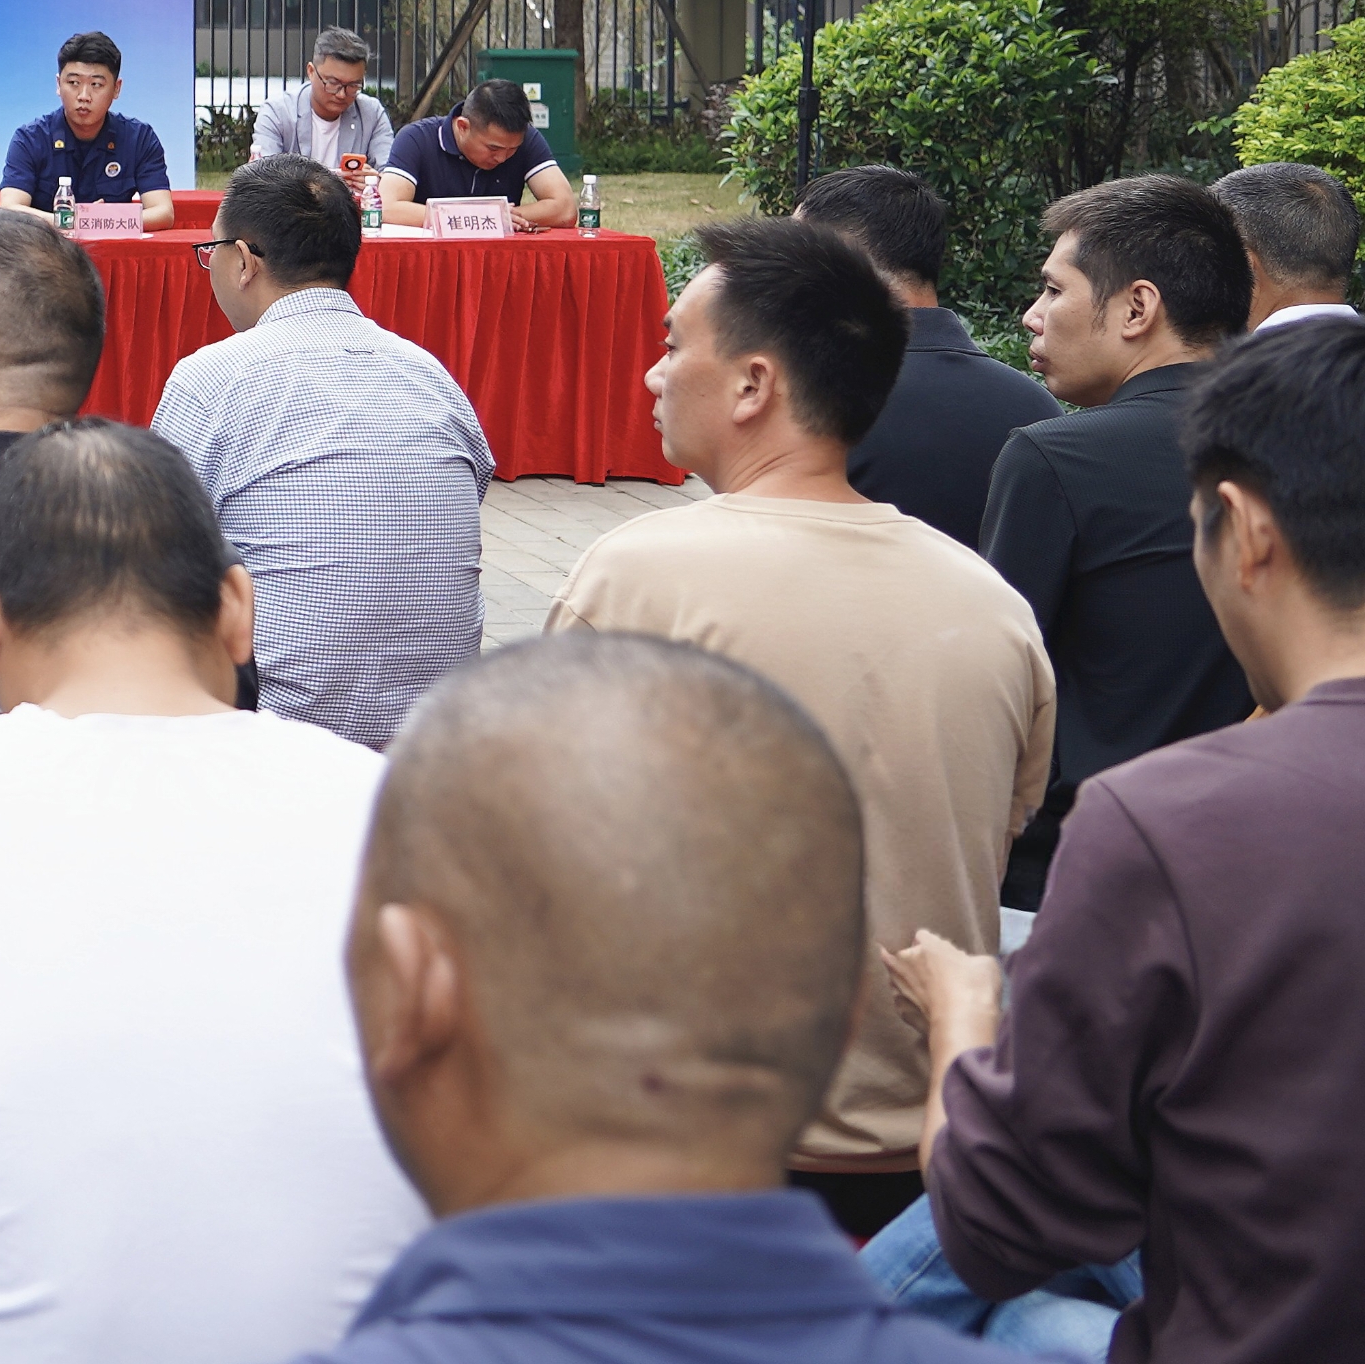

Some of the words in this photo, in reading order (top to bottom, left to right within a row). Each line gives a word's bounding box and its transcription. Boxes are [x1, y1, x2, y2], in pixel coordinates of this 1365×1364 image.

[78, 217, 140, 230] 区消防大队
[447, 215, 497, 231] 崔明杰
